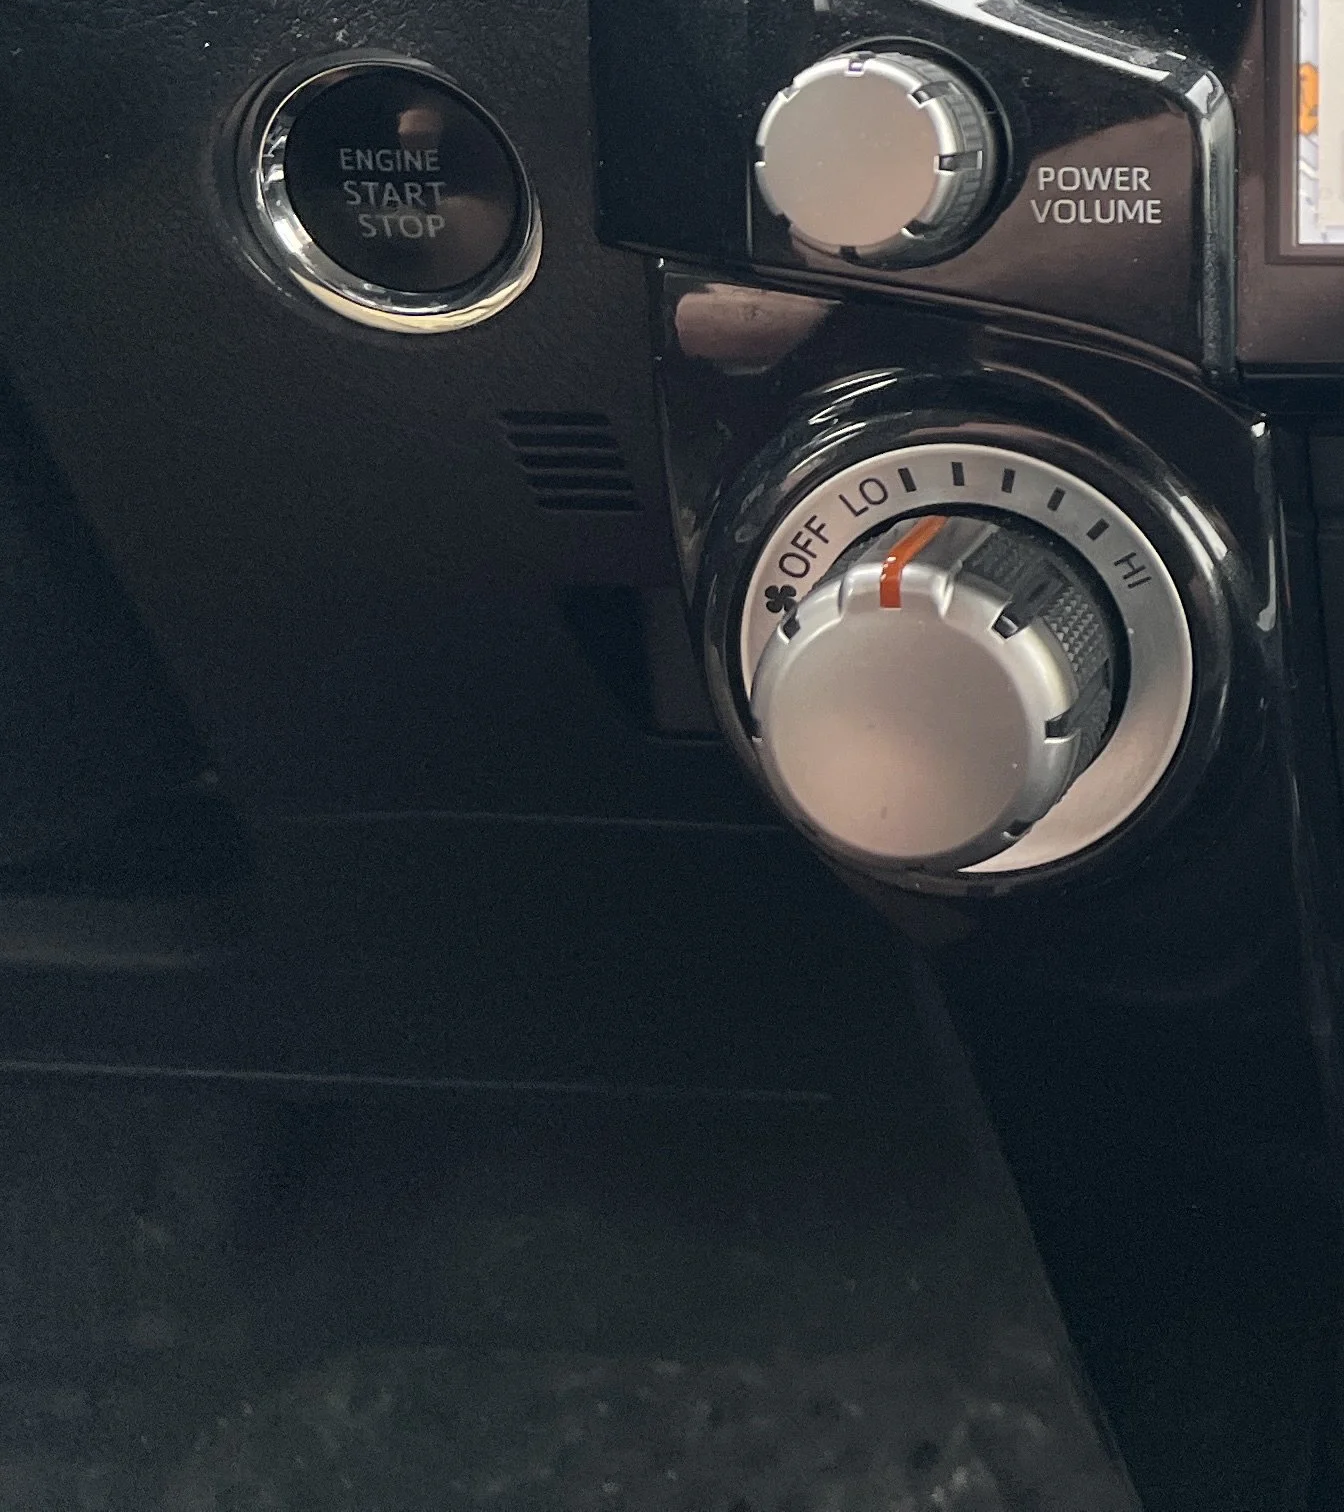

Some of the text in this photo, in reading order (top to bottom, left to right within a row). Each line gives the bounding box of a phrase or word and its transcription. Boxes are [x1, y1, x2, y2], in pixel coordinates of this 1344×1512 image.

[340, 148, 441, 172] ENGINE
[1038, 167, 1151, 191] POWER
[343, 181, 446, 207] START
[1031, 199, 1162, 224] VOLUME
[358, 214, 446, 239] STOP
[839, 478, 889, 517] LO
[778, 515, 831, 578] OFF
[1113, 552, 1152, 589] HI
